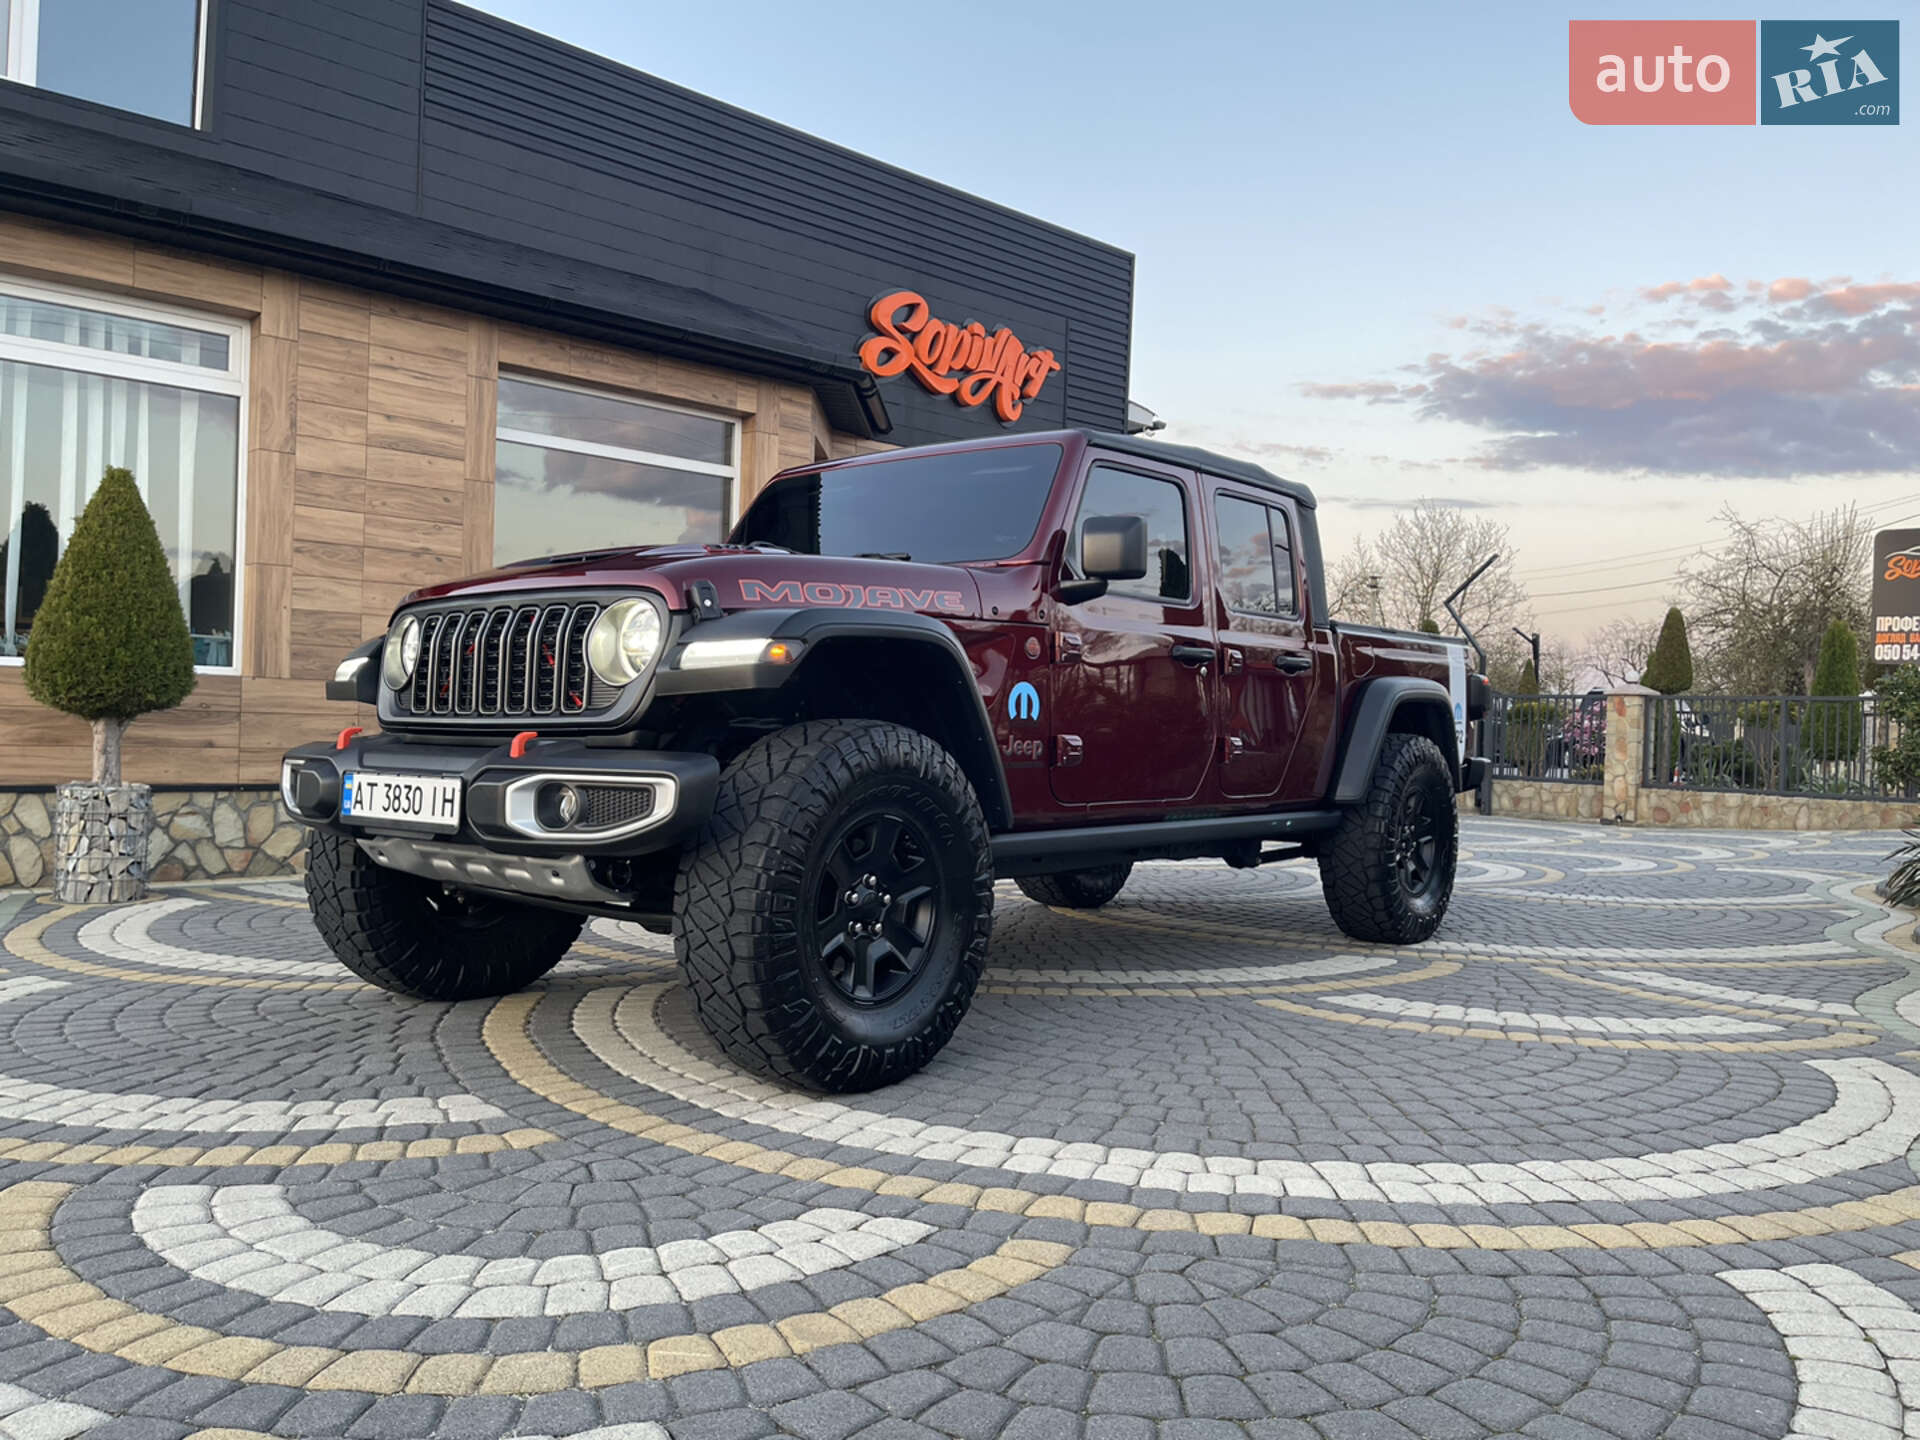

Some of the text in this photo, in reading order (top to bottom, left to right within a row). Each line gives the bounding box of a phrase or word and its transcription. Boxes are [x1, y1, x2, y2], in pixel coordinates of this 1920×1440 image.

[738, 579, 965, 612] MOJAVE
[1874, 644, 1900, 660] 050
[1003, 734, 1044, 760] Jeep
[353, 781, 456, 818] AT 3830 IH
